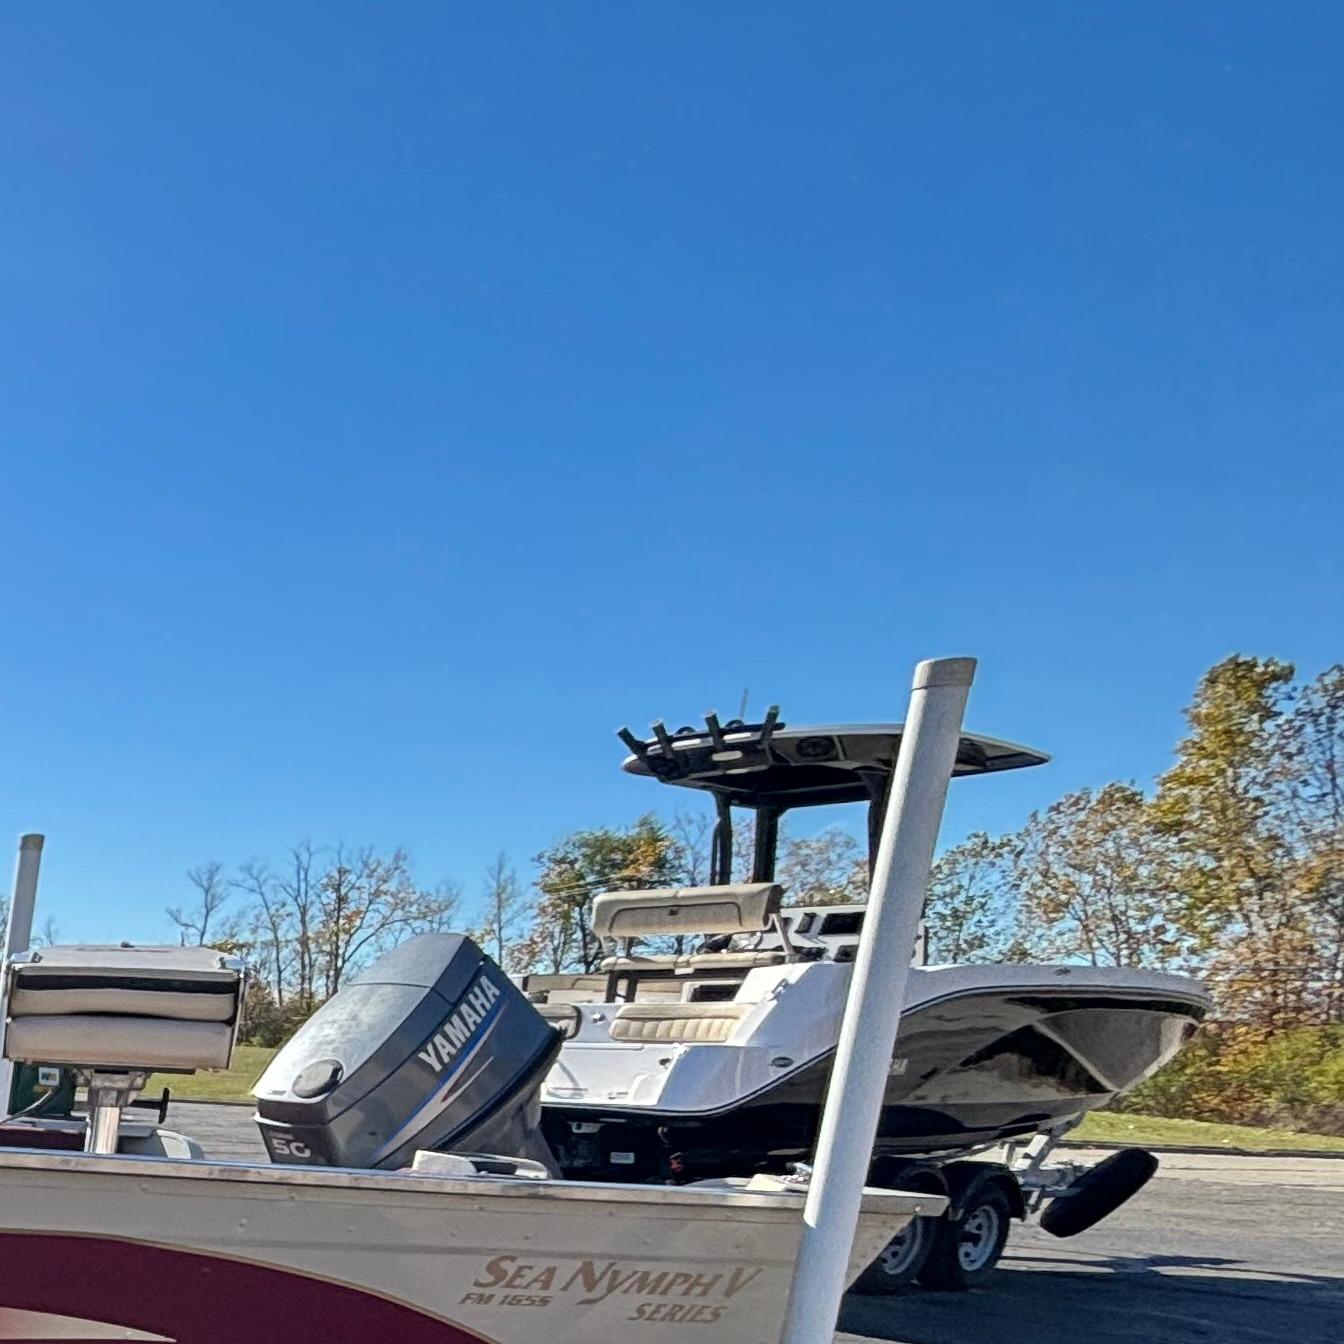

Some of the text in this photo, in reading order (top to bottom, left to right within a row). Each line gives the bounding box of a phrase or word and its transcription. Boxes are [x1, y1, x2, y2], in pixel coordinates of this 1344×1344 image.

[417, 975, 501, 1072] YAMAHA
[472, 1255, 558, 1291] SEA
[723, 1266, 764, 1298] V
[497, 1294, 555, 1308] 1655
[626, 1302, 729, 1323] SERIES
